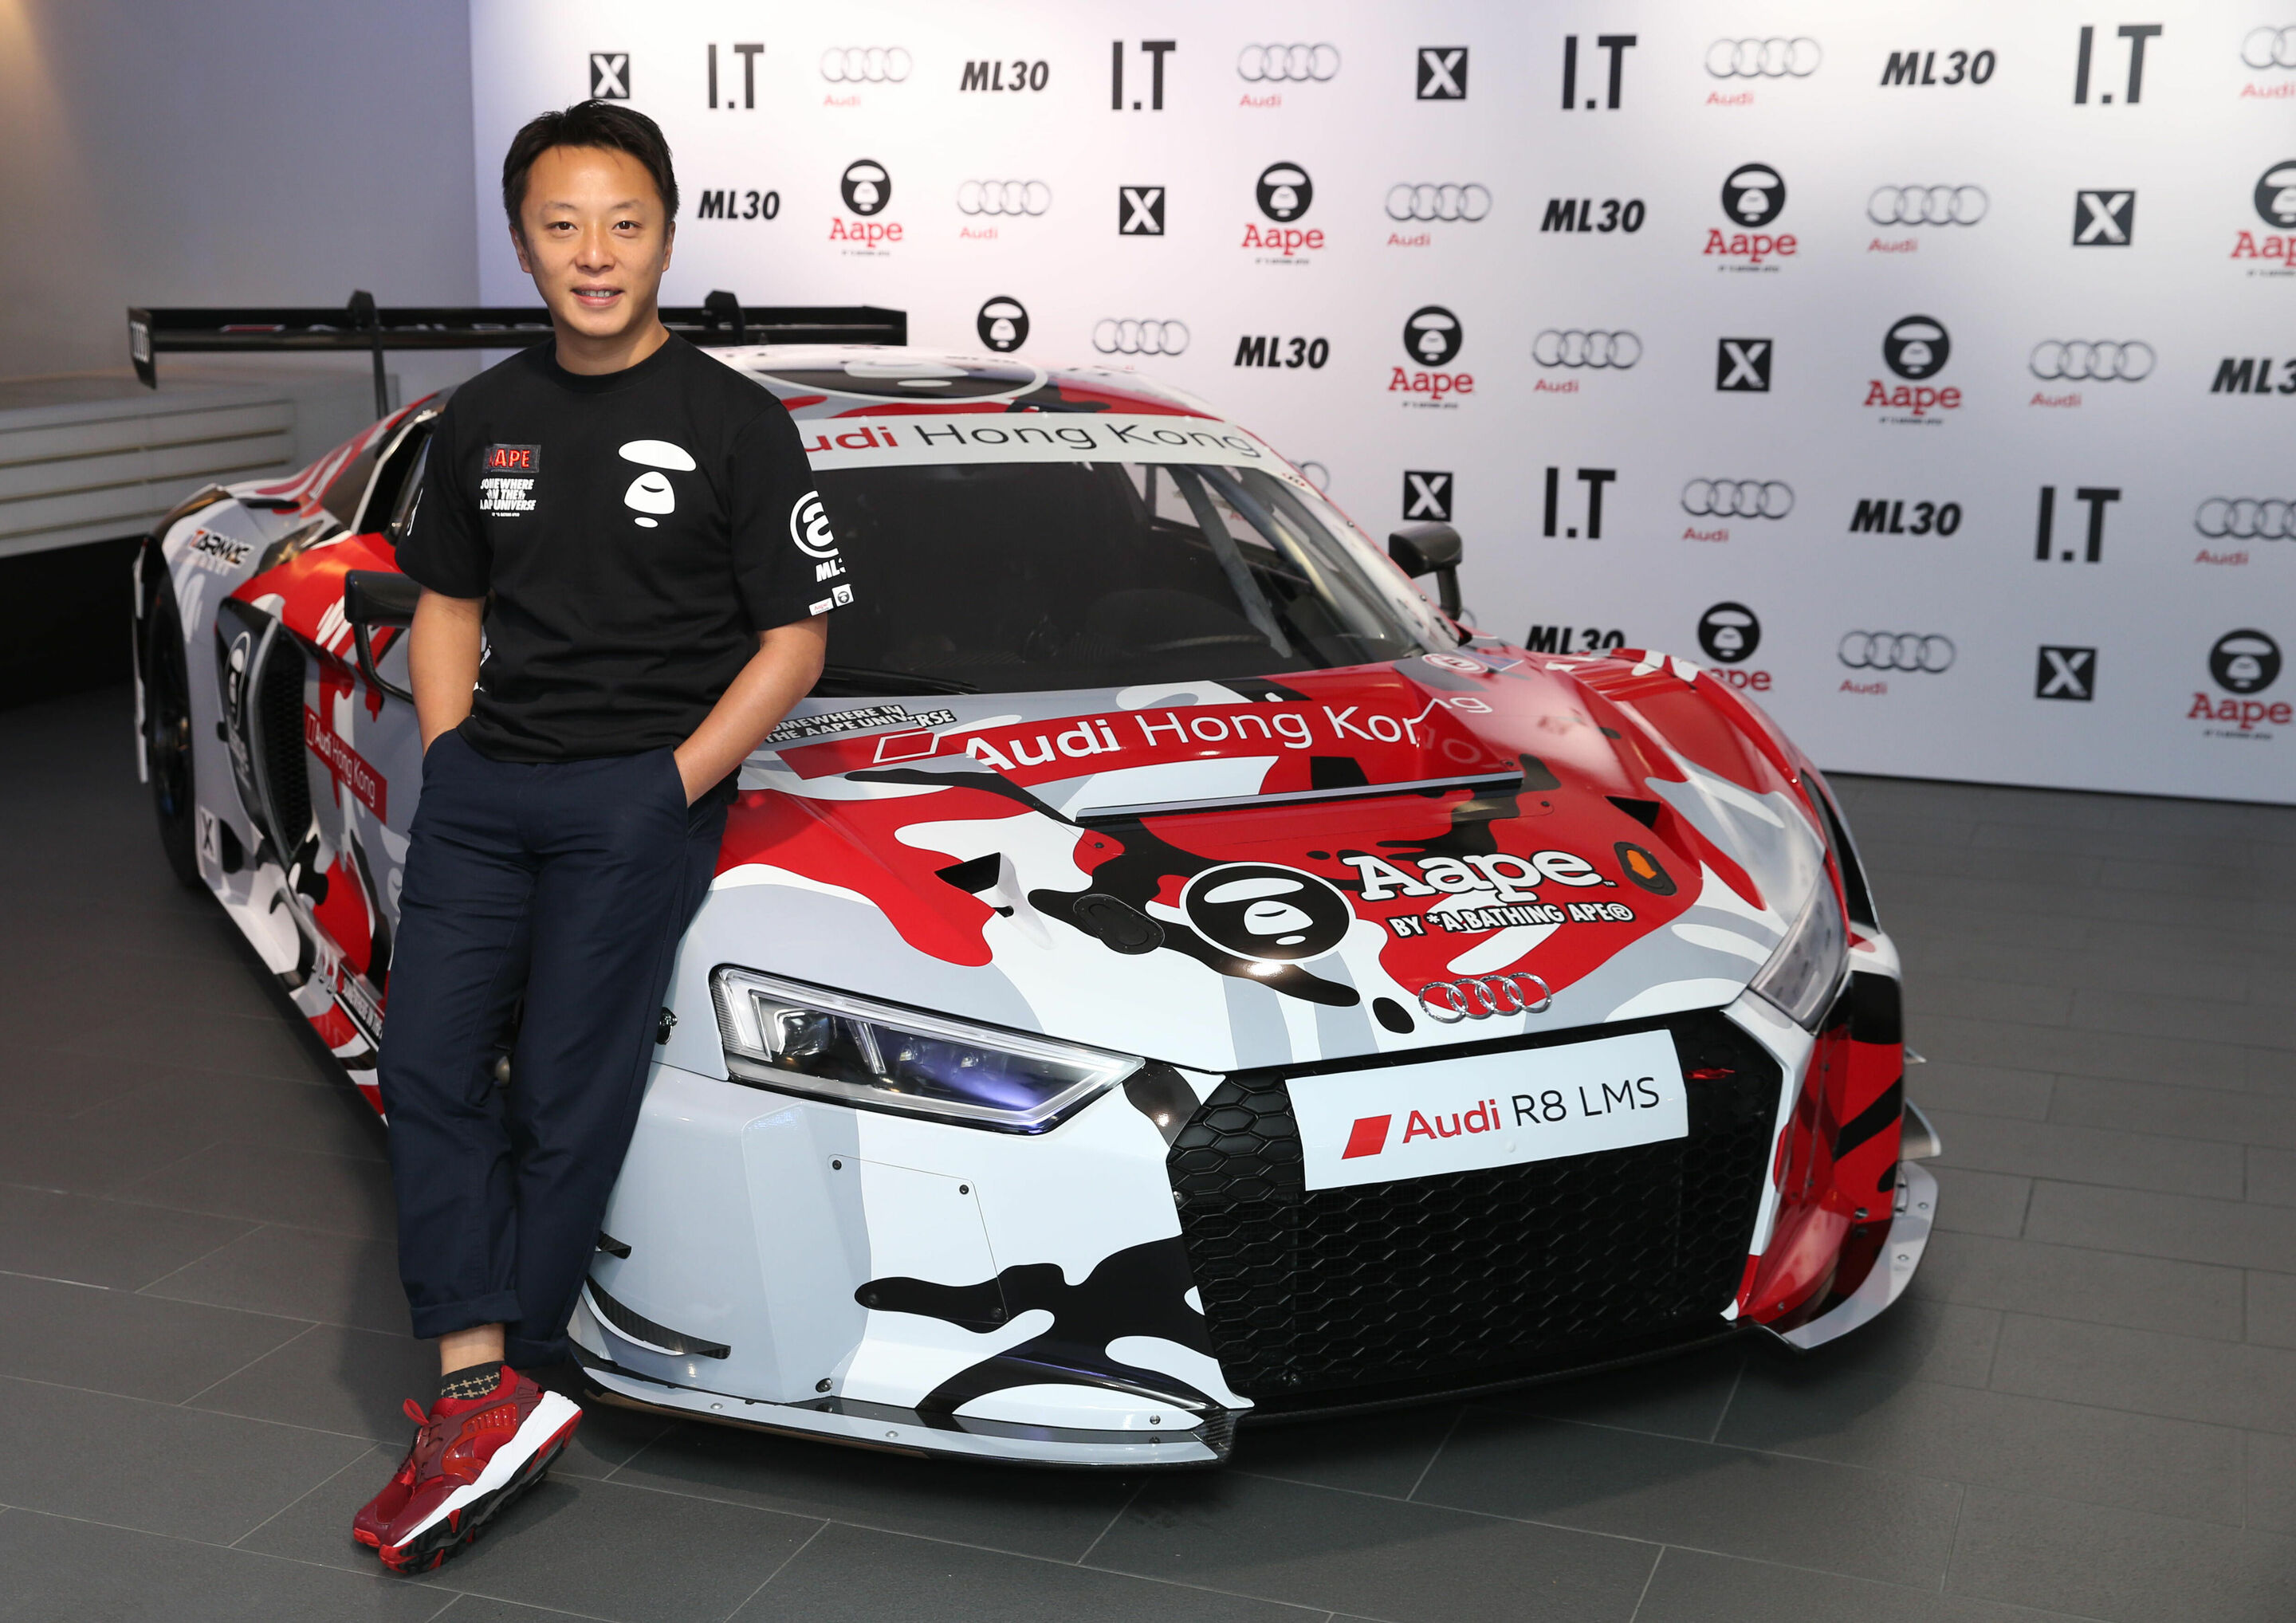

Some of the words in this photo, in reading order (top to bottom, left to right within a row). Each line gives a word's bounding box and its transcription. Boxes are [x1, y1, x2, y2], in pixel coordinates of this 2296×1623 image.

[592, 55, 627, 97] X
[708, 44, 765, 109] I.T
[960, 61, 1049, 92] ML30
[1112, 41, 1176, 110] I.T
[1421, 50, 1463, 96] X
[1562, 35, 1637, 110] I.T
[1881, 49, 1995, 86] ML30
[2074, 25, 2162, 104] I.T
[824, 94, 862, 107] Audi
[1239, 93, 1283, 108] Audi
[1706, 91, 1755, 106] Audi
[2240, 82, 2296, 98] Audi
[698, 190, 780, 221] ML30
[1122, 189, 1161, 233] X
[1540, 198, 1645, 234] ML30
[2078, 195, 2130, 242] X
[829, 217, 903, 249] Aape
[959, 226, 999, 240] Audi
[1241, 223, 1325, 257] Aape
[1386, 233, 1431, 247] Audi
[1704, 229, 1798, 264] Aape
[1868, 238, 1917, 253] Audi
[1234, 336, 1330, 370] ML30
[1720, 340, 1768, 389] X
[1388, 367, 1474, 401] Aape
[1534, 379, 1580, 393] Audi
[2211, 358, 2296, 395] ML3
[1864, 379, 1962, 417] Aape
[2030, 392, 2082, 407] Audi
[805, 425, 898, 452] udi
[914, 424, 1096, 449] Hong
[1106, 424, 1261, 458] Kong
[493, 499, 537, 511] UNIVERSE
[1406, 474, 1449, 520] X
[1543, 466, 1617, 540] I.T
[1682, 527, 1729, 543] Audi
[1849, 499, 1962, 537] ML30
[2035, 486, 2121, 564] I.T
[2195, 549, 2250, 565] Audi
[1524, 624, 1625, 654] ML30
[1709, 666, 1771, 691] ape
[1838, 678, 1889, 696] Audi
[2038, 648, 2093, 698] X
[807, 718, 859, 736] AAPE
[858, 709, 955, 727] UNIVERSE
[2188, 692, 2293, 731] Aape
[965, 717, 1121, 772] Audi
[1136, 711, 1313, 749] Hong
[1322, 697, 1493, 745] Kong
[314, 722, 332, 758] Audi
[332, 736, 353, 785] Hong
[353, 758, 375, 808] Kong
[1389, 915, 1425, 937] BY
[1462, 903, 1565, 930] BATHING
[1402, 1098, 1502, 1144] Audi
[1513, 1090, 1567, 1126] R8
[1579, 1077, 1660, 1117] LMS
